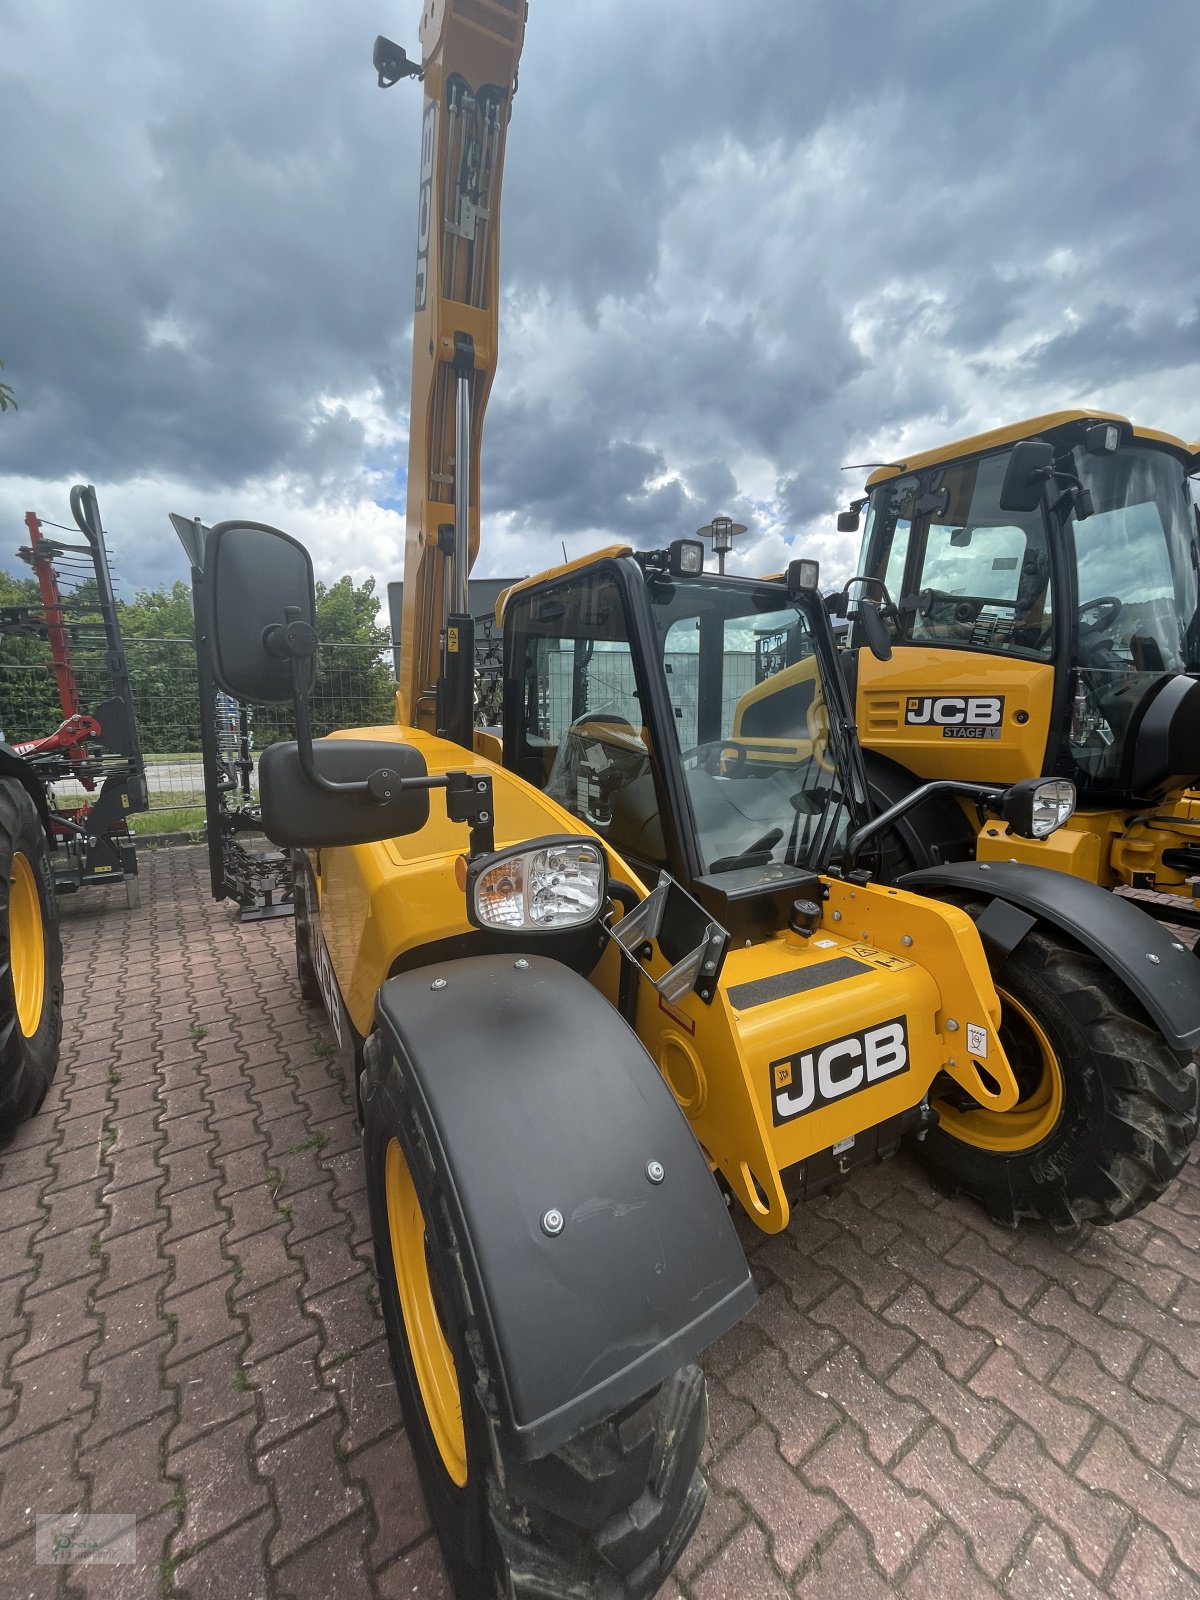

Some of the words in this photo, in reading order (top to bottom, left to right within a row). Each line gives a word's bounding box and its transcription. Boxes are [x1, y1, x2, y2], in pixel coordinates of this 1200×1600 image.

[417, 106, 435, 306] JCB
[907, 698, 1001, 724] JCB
[944, 727, 983, 738] STAGE
[990, 729, 998, 737] V
[776, 1023, 907, 1117] JCB
